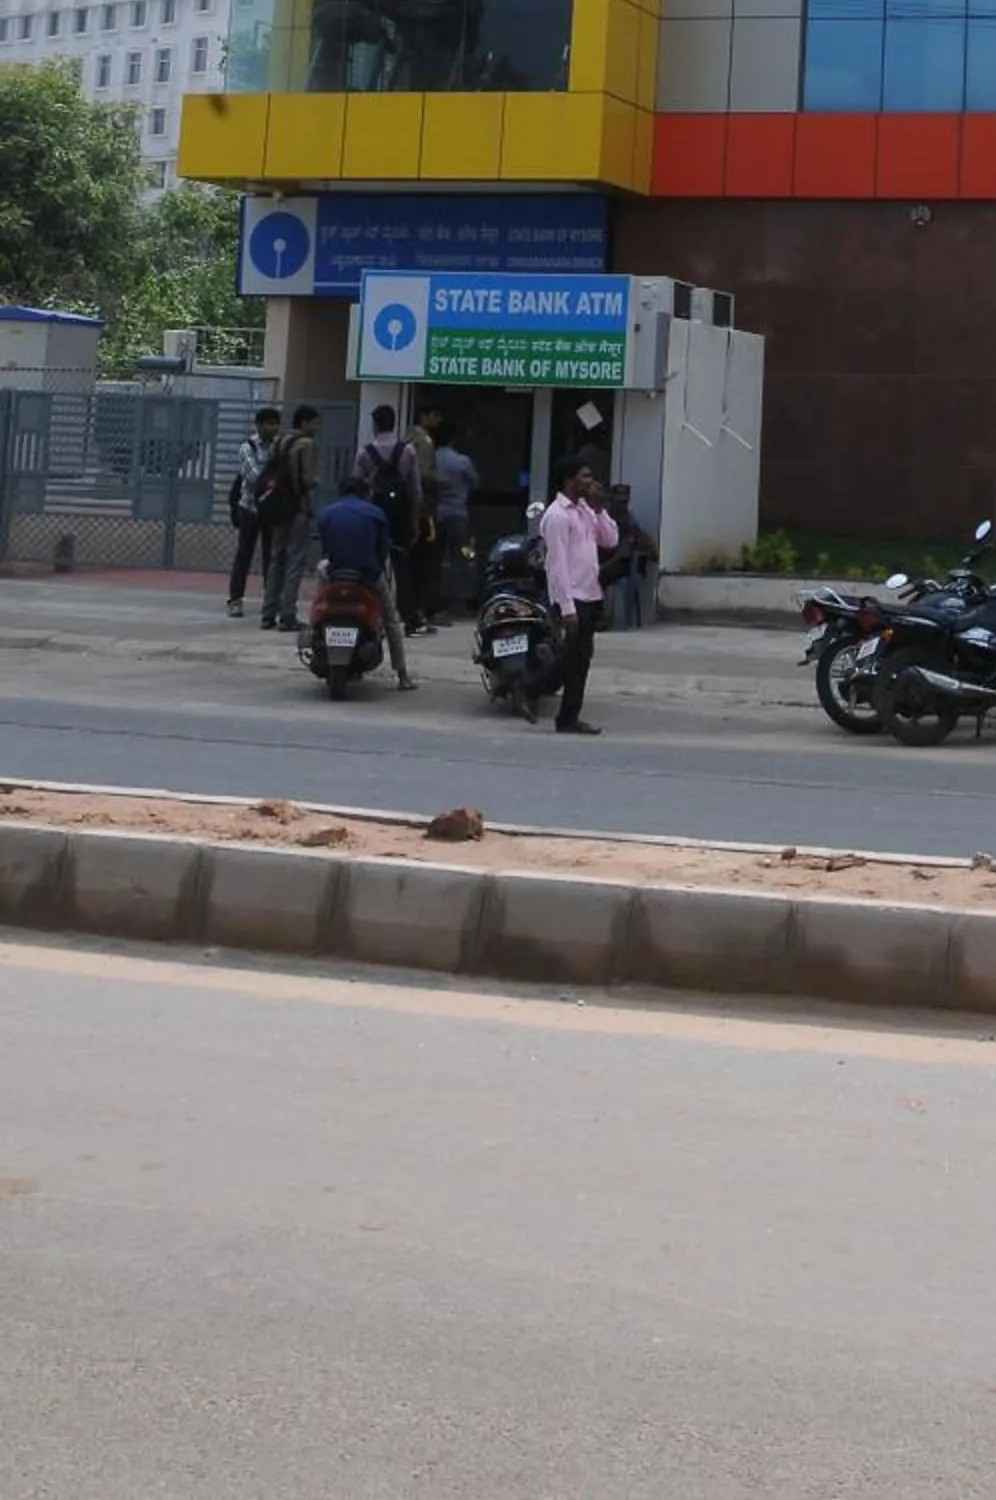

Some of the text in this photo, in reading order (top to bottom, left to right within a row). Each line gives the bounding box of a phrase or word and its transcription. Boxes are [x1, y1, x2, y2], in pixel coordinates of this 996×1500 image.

[434, 289, 623, 316] STATE BANK ATM
[429, 355, 622, 380] STATE BANK OF MYSORE
